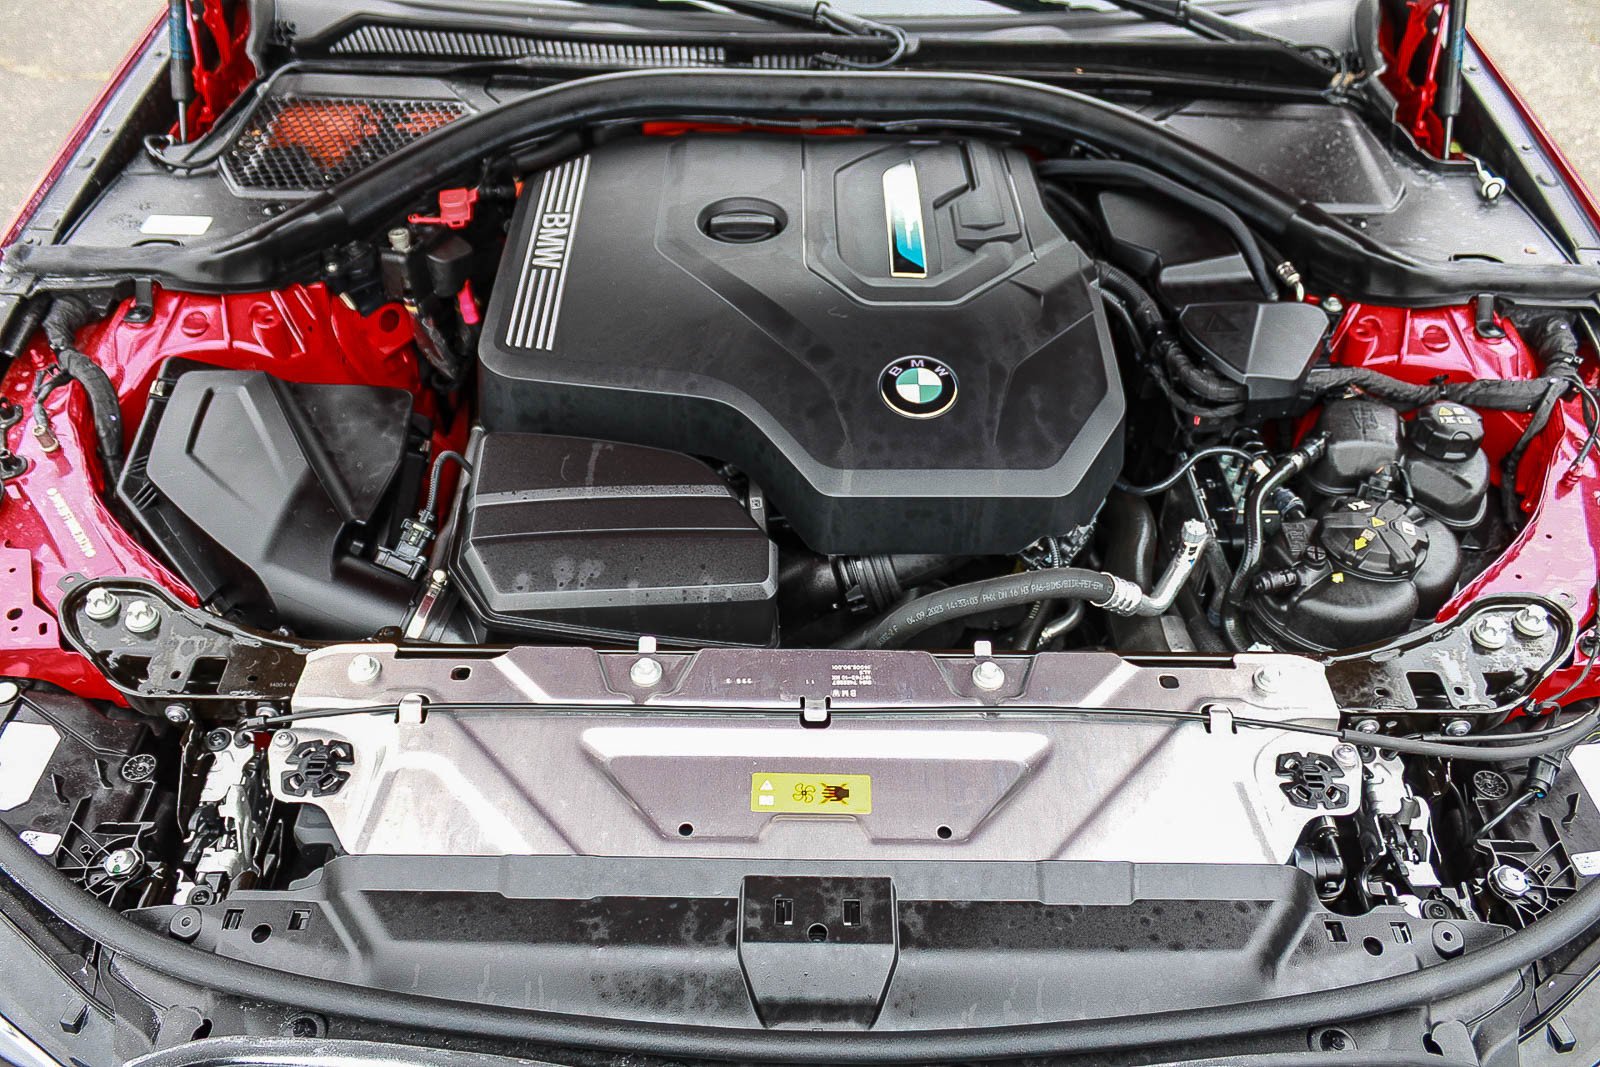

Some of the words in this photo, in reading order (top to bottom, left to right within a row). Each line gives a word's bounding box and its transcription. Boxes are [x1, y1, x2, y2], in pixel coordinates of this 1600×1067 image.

[532, 213, 571, 269] BMW
[888, 359, 949, 377] BMW
[906, 604, 944, 625] 04.09.2023
[832, 689, 857, 697] BMW
